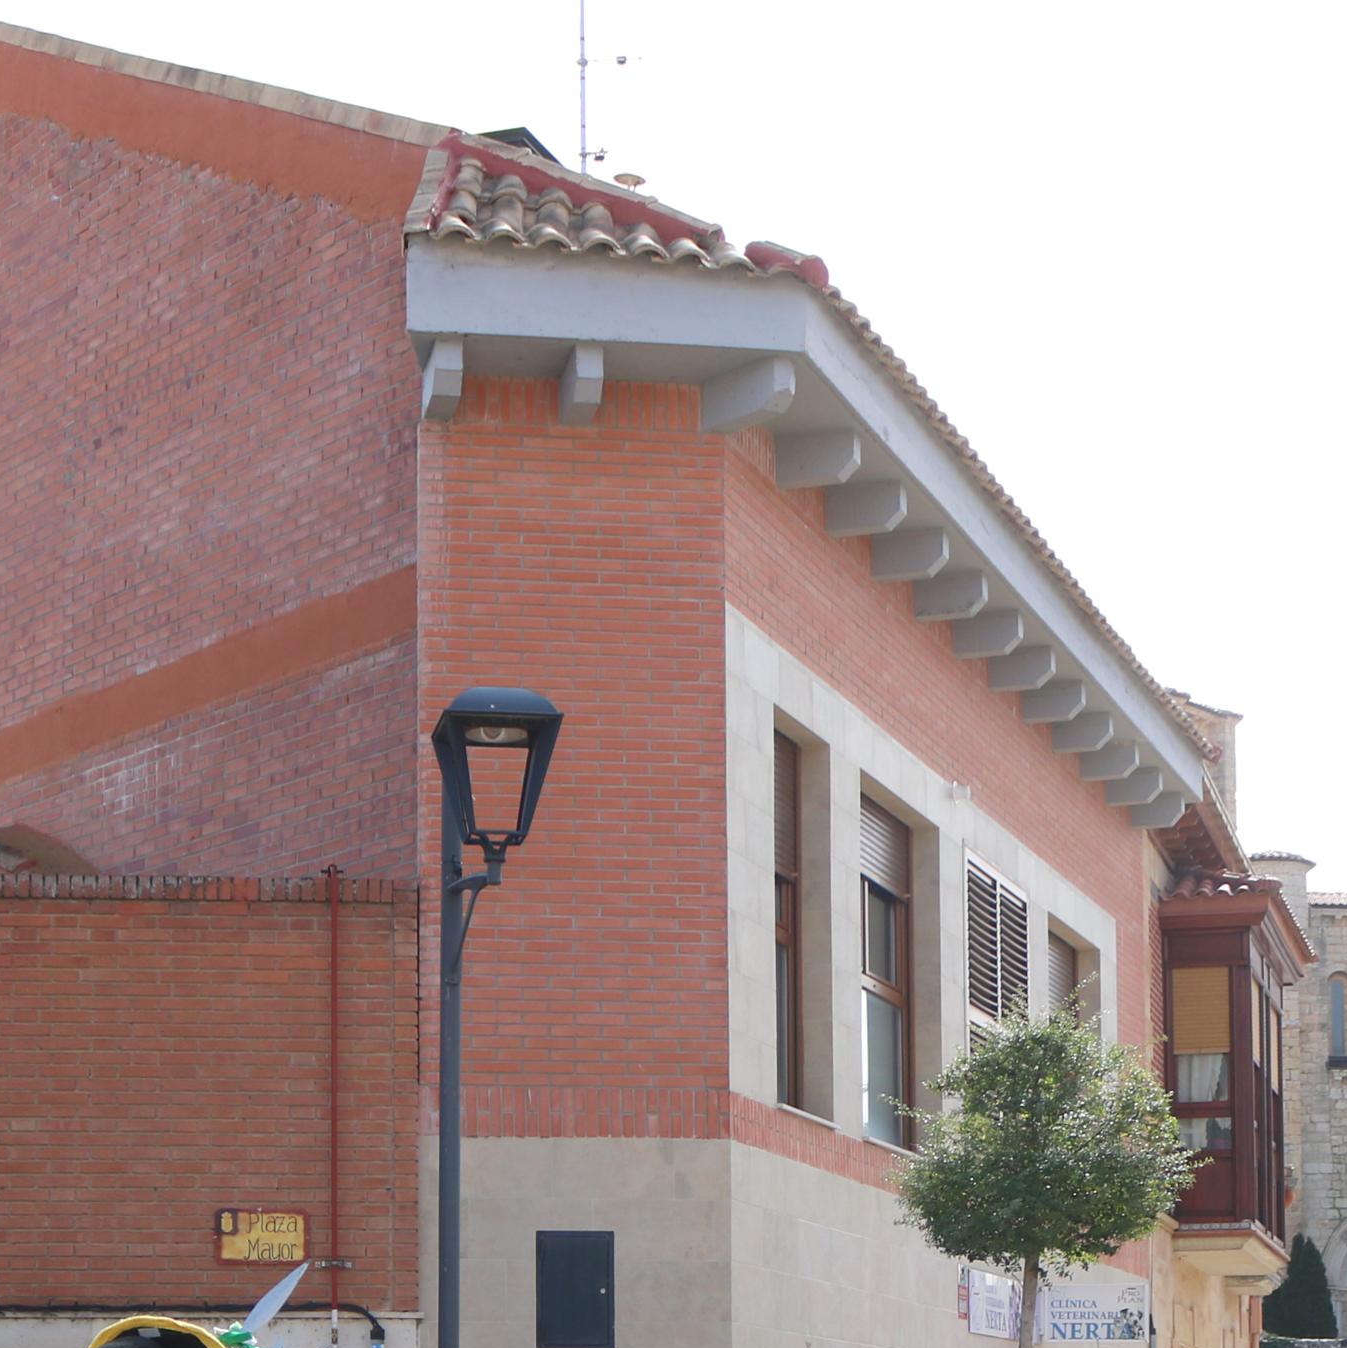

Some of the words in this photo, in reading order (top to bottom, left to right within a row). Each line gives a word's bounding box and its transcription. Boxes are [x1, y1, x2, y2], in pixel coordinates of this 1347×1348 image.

[246, 1212, 298, 1234] Plaza
[244, 1237, 298, 1263] Mayor
[1050, 1298, 1098, 1309] CLÍNICA
[1049, 1322, 1135, 1341] NERTA
